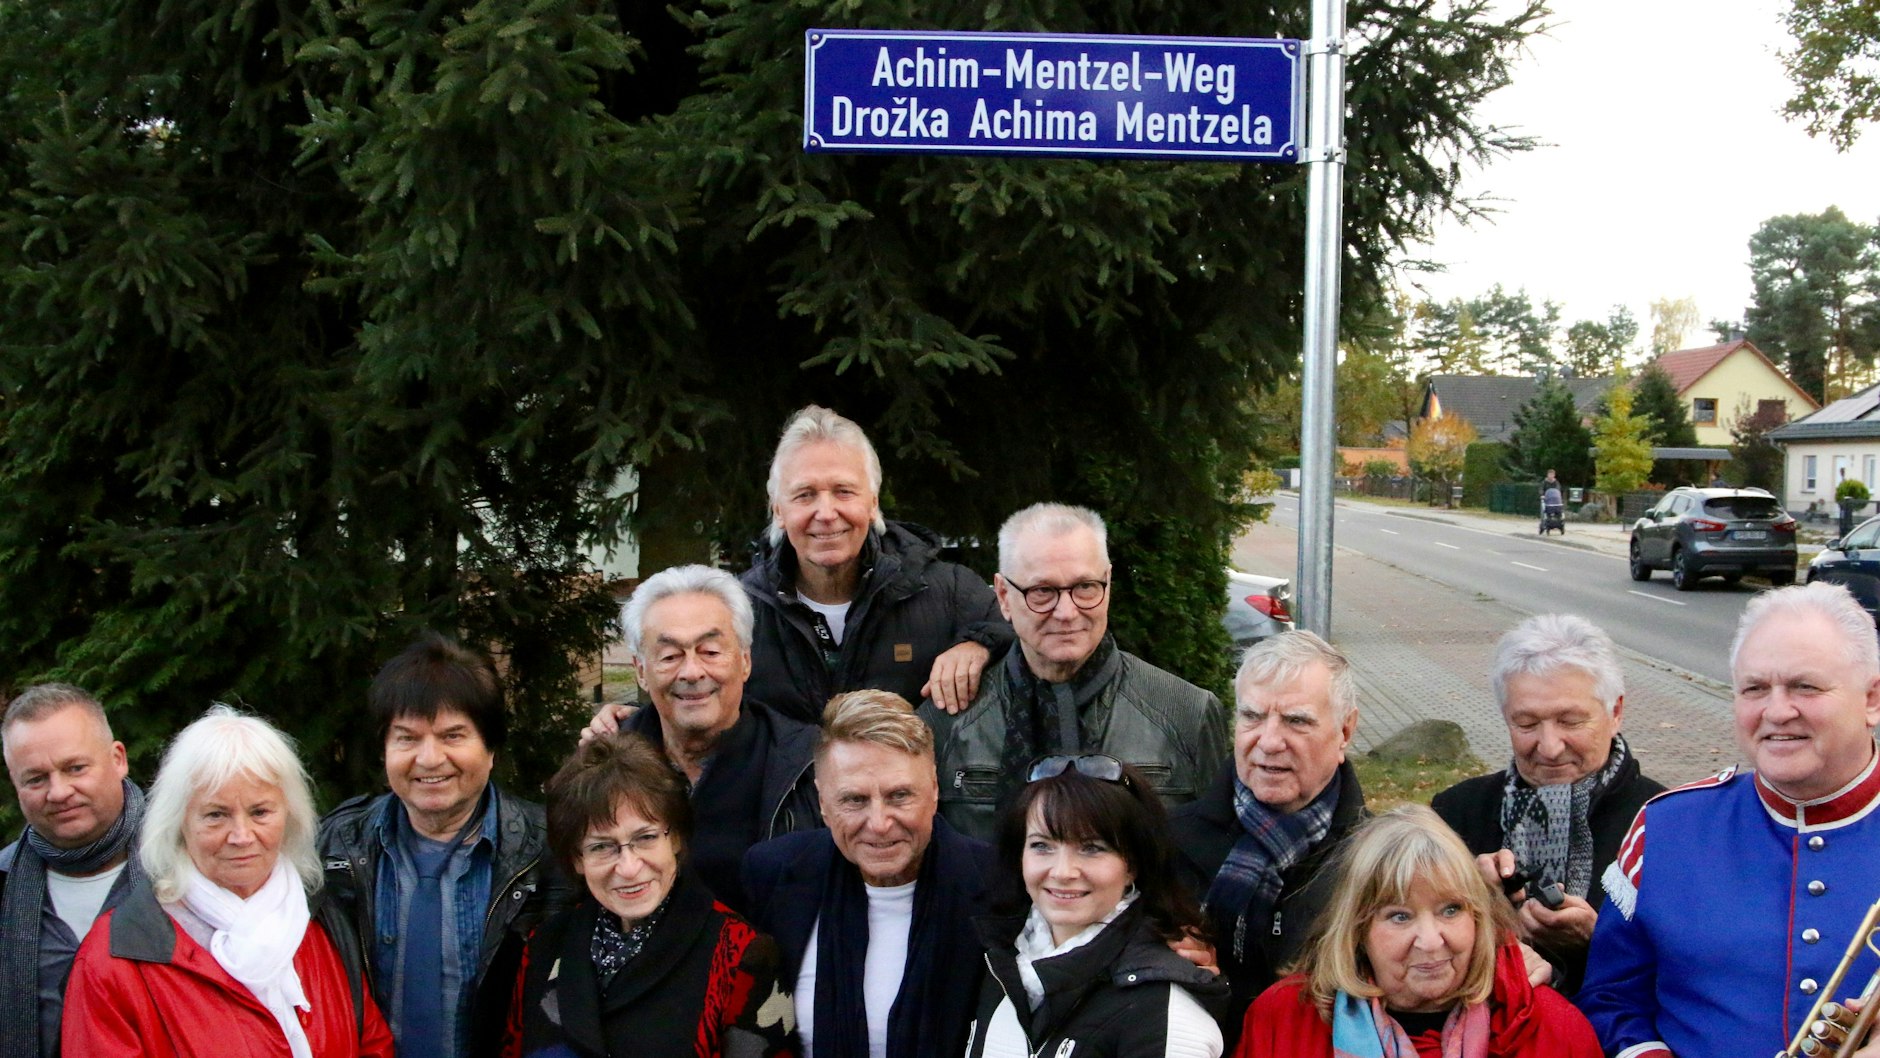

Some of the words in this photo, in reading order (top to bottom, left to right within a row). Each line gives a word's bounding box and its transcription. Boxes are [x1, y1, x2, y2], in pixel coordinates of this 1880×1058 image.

[871, 46, 1236, 106] Achim-Mentzel-Weg
[832, 95, 950, 139] Drožka
[969, 97, 1097, 141] Achima
[1116, 100, 1272, 145] Mentzela
